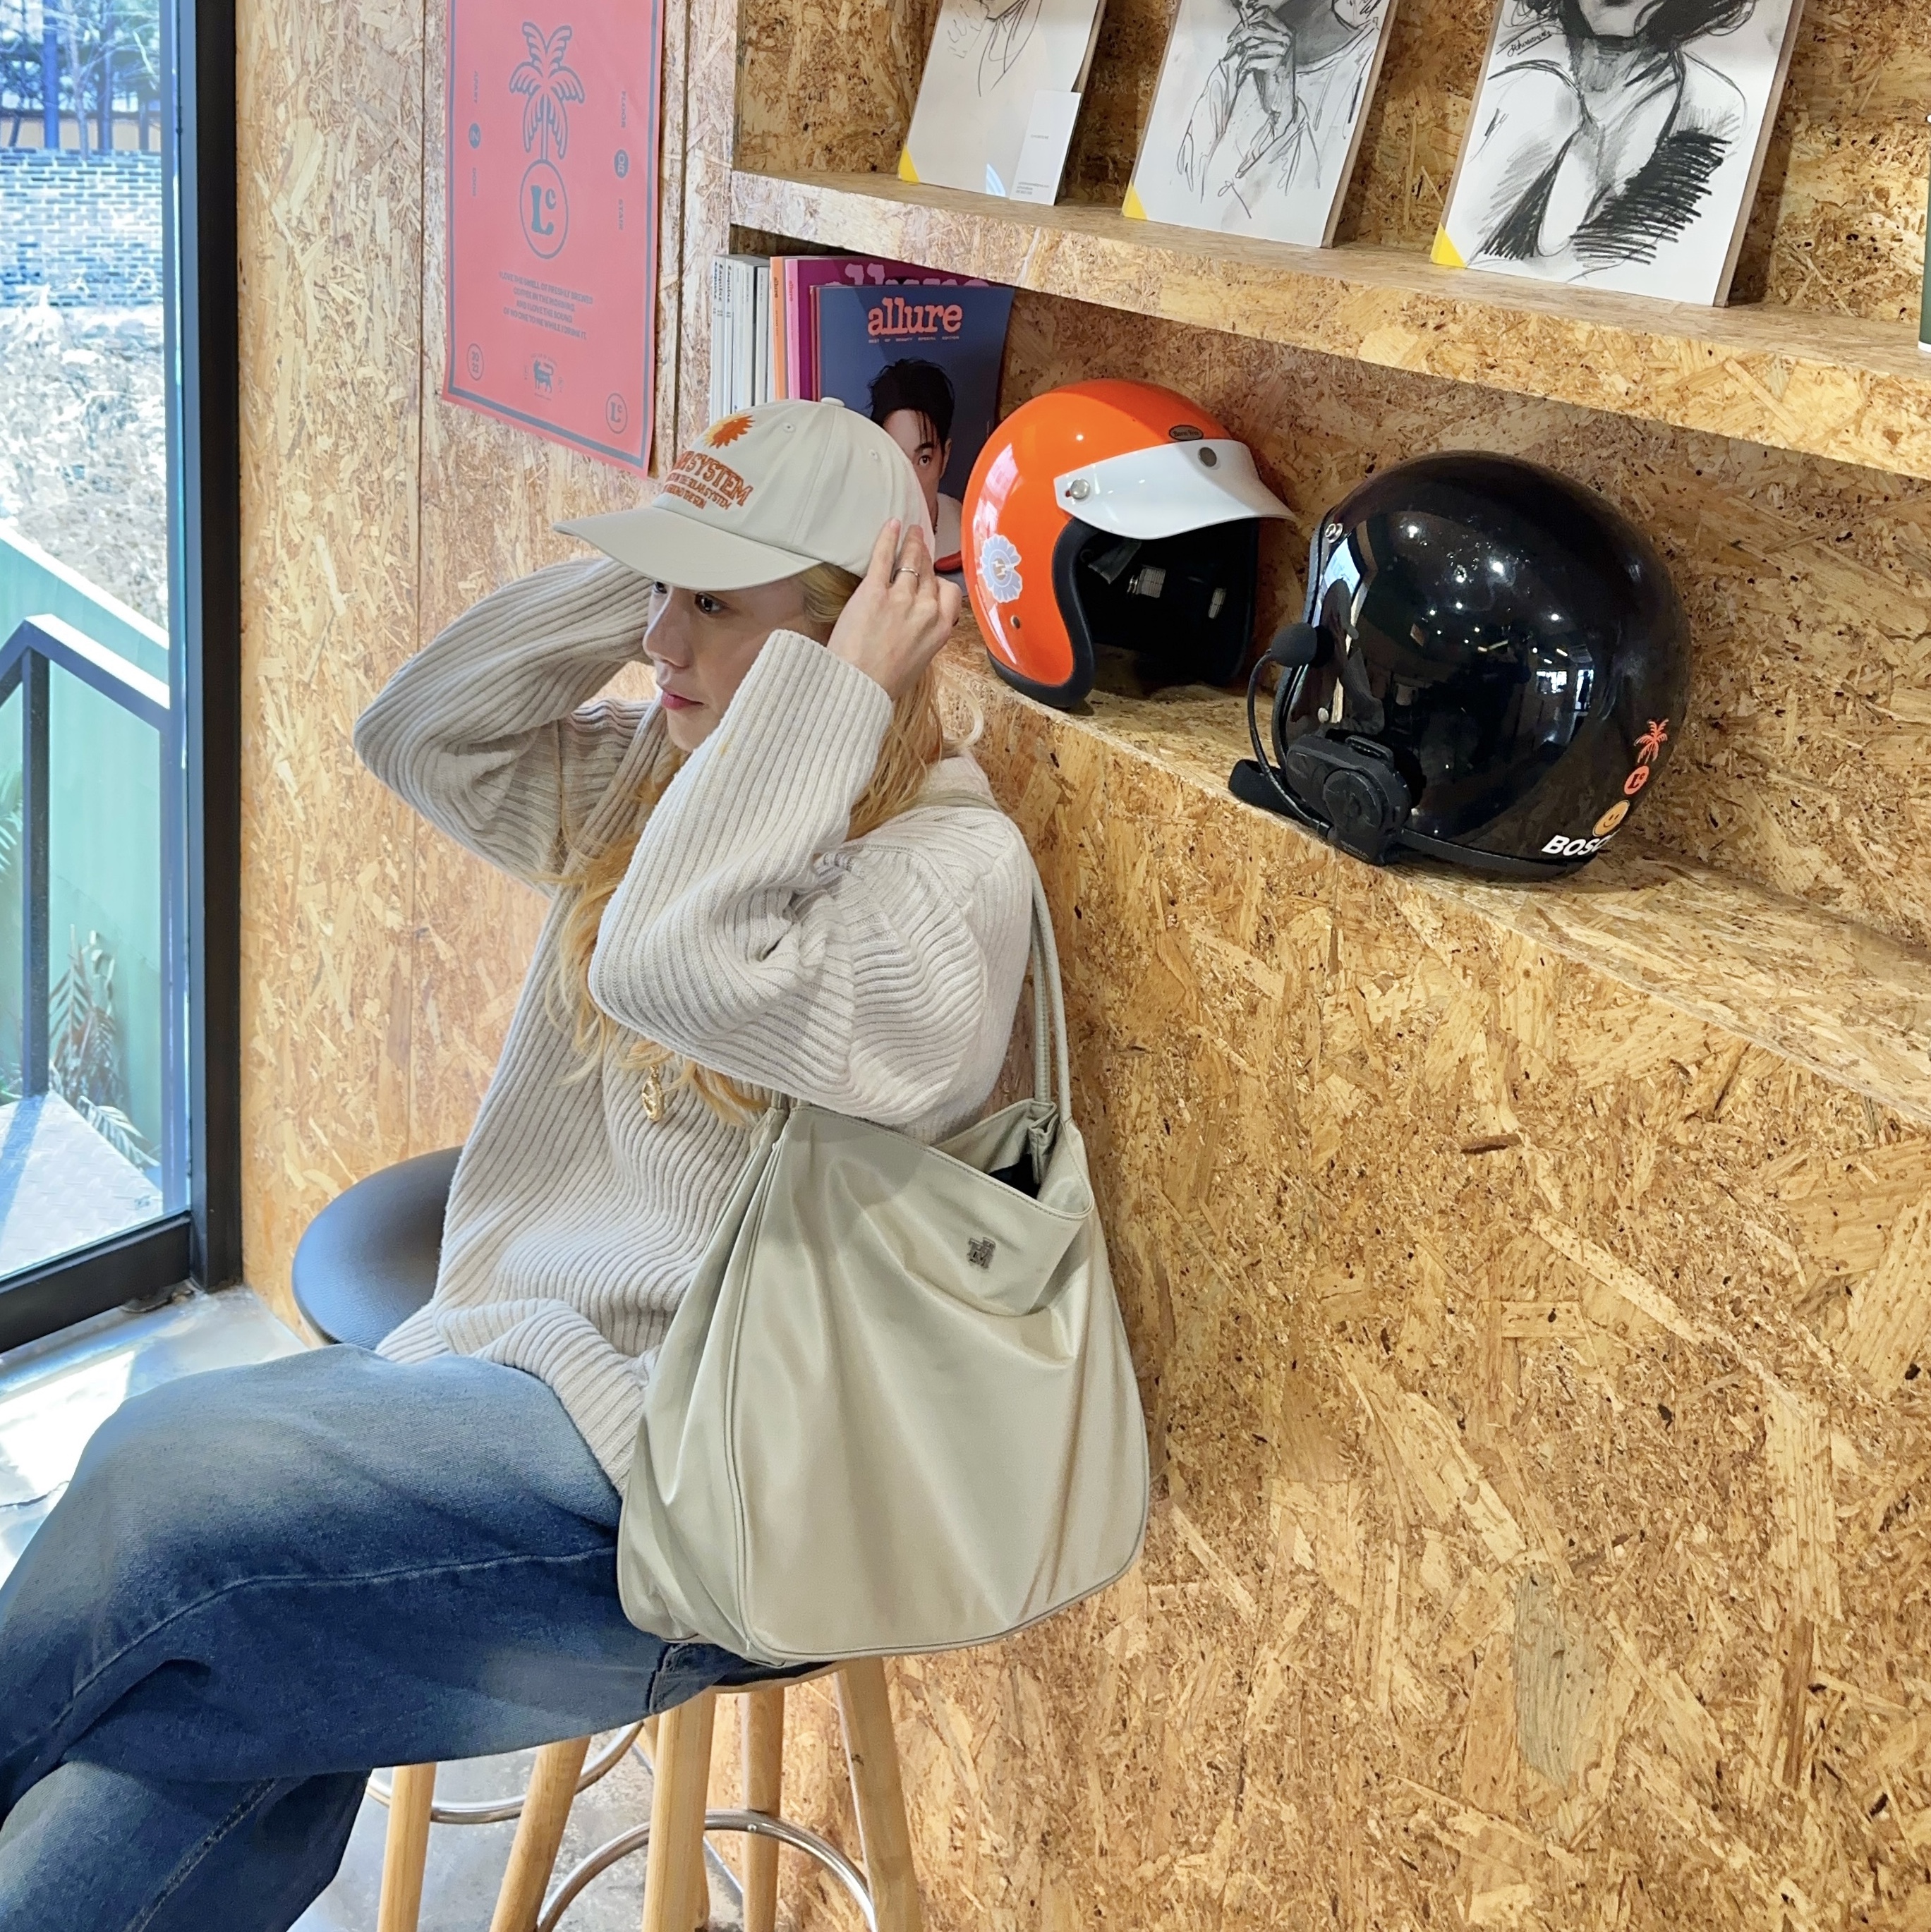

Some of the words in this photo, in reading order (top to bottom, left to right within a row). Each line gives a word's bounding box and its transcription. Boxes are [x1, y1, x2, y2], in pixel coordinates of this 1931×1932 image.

[868, 297, 962, 336] allure
[685, 452, 753, 506] SYSTEM
[703, 487, 732, 510] SYSTEM
